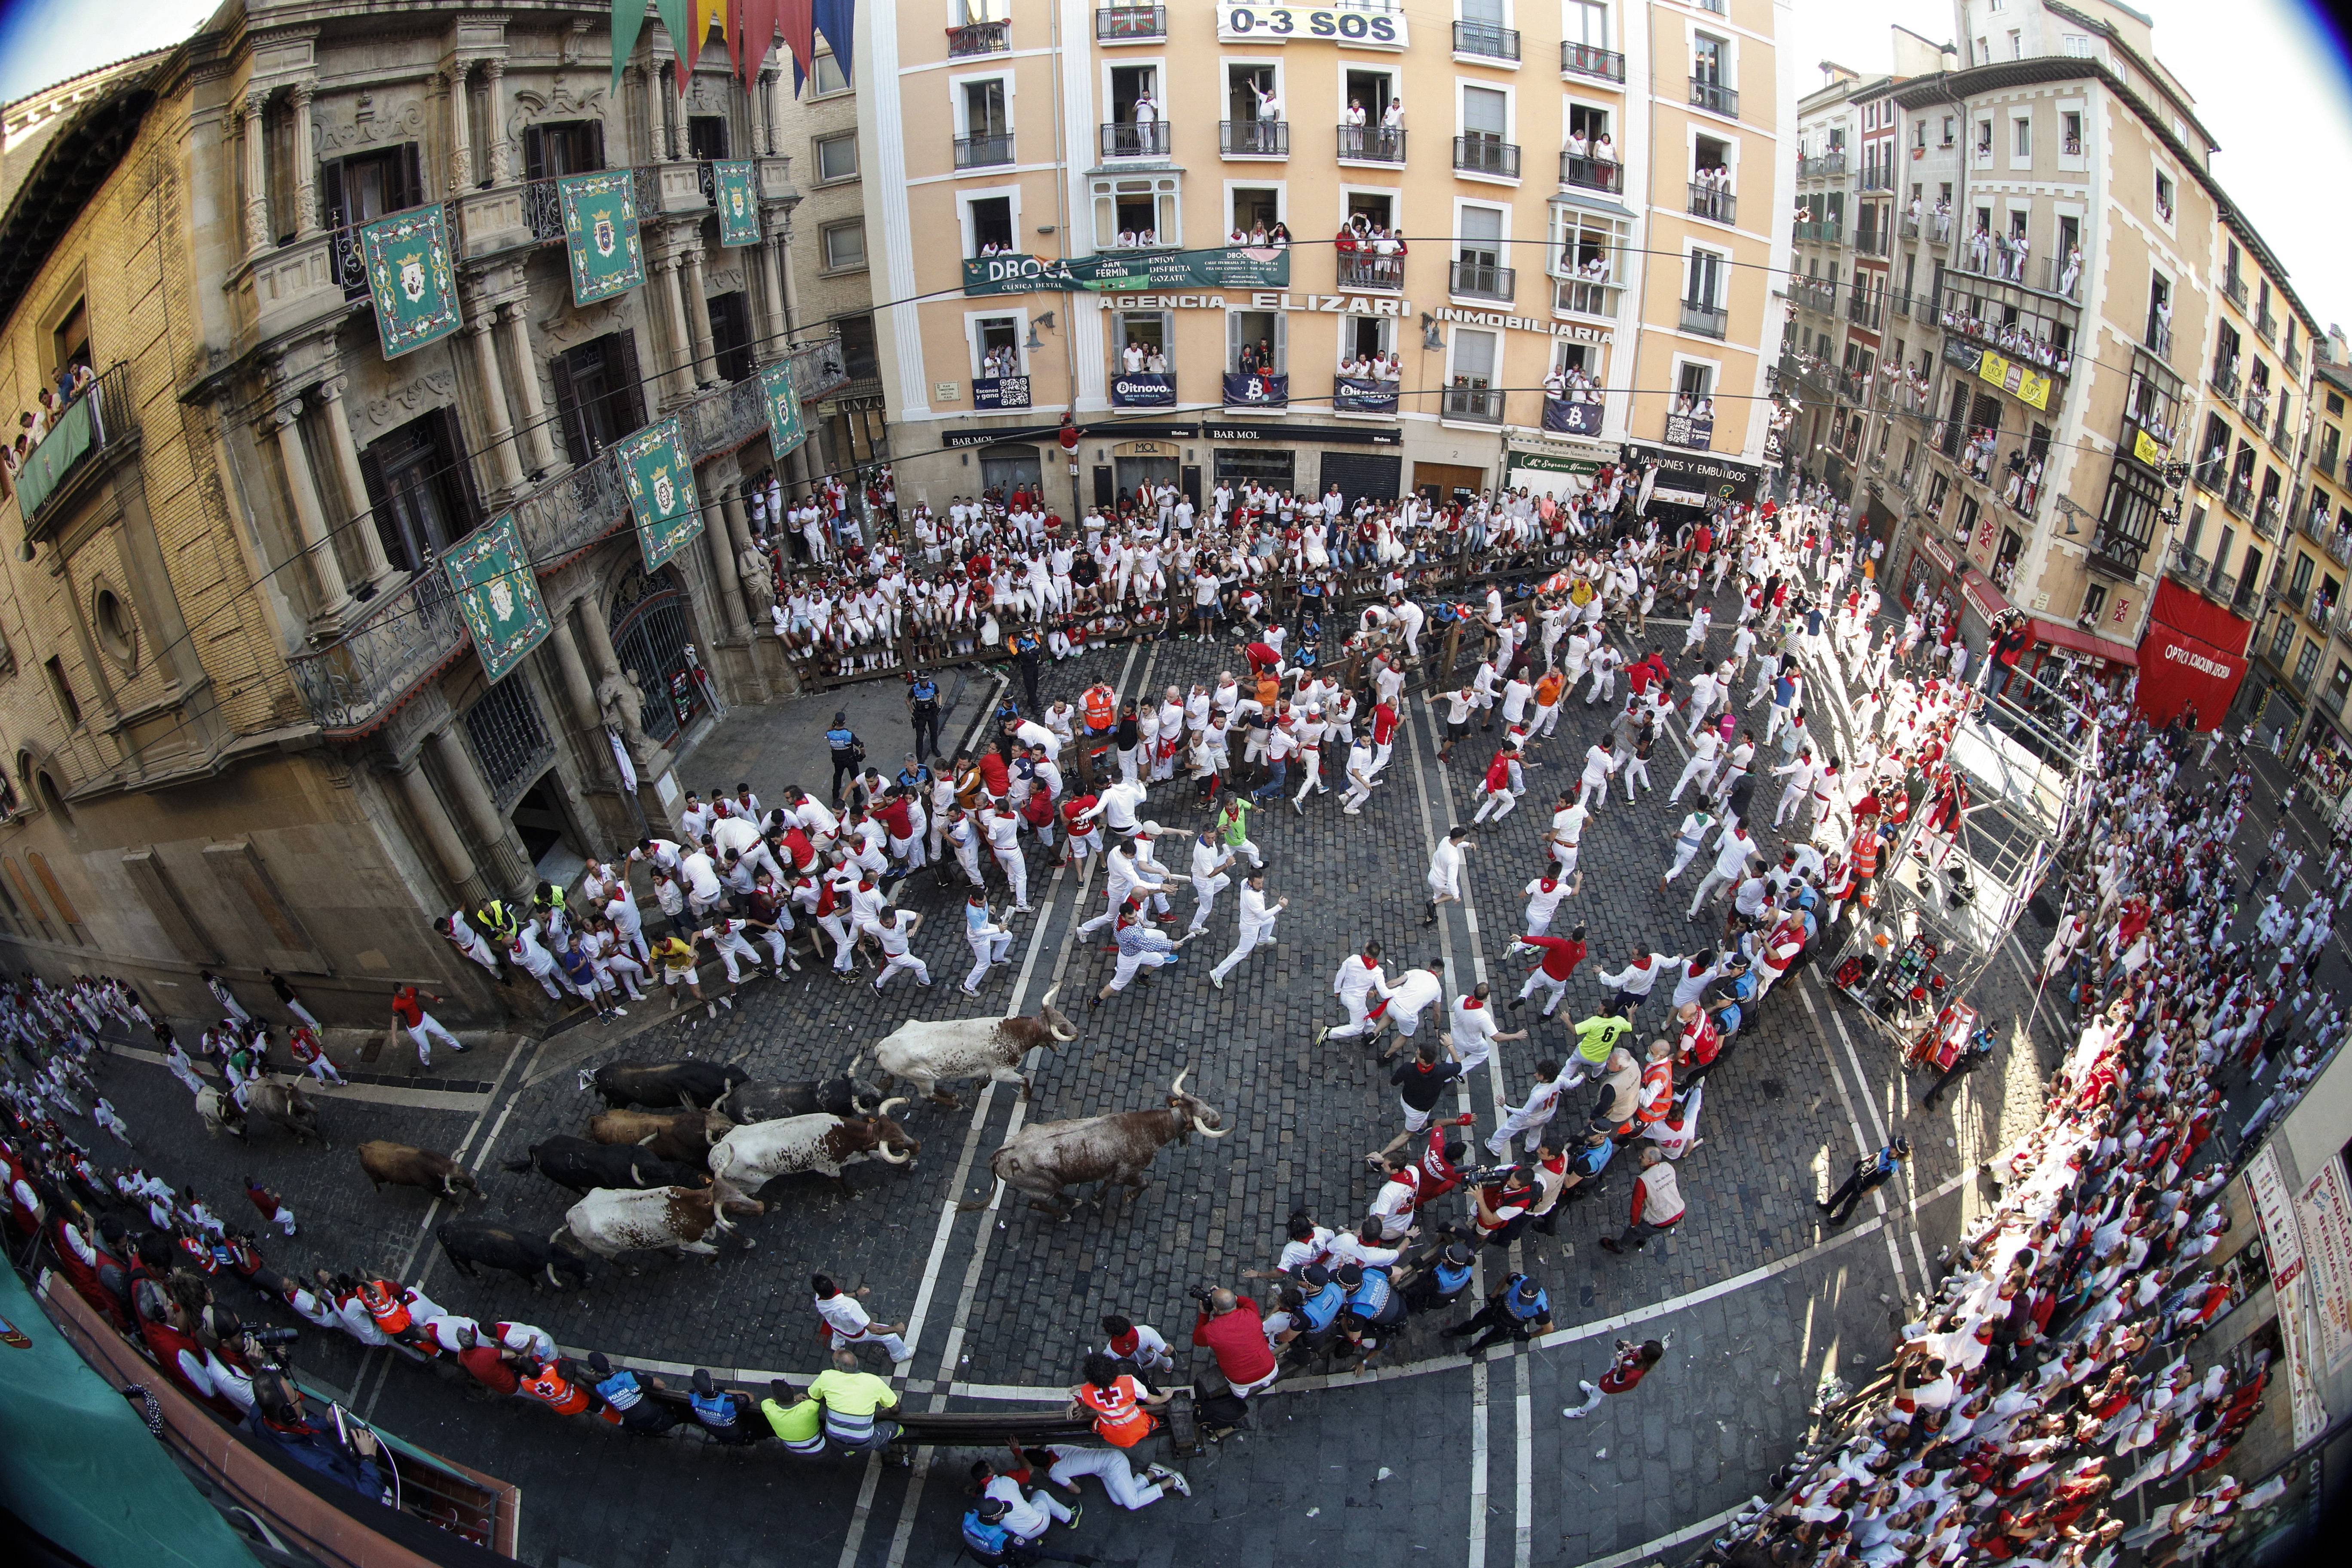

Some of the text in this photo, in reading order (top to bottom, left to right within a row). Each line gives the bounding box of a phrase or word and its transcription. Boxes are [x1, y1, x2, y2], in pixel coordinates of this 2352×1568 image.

[1230, 9, 1395, 41] 0-3 SOS
[989, 259, 1073, 282] DBOCA
[1096, 267, 1128, 278] FERMÍN
[1102, 260, 1120, 268] SAN
[1097, 293, 1411, 317] AGENCIA ELIZARI
[1436, 306, 1615, 345] INMOBILIARIA
[1213, 430, 1260, 439] BAR MOL
[1135, 443, 1157, 452] MOL
[1541, 459, 1569, 468] Sagrario
[1569, 463, 1595, 472] Navarro
[1688, 463, 1694, 472] Y
[2165, 644, 2190, 665] OPTICA
[1602, 1026, 1615, 1043] 6
[2312, 1198, 2326, 1212] DOG
[2317, 1189, 2330, 1202] HOT
[2323, 1165, 2352, 1258] BOCADILLOS
[2327, 1212, 2351, 1299] HOT SANDWICHES
[2294, 1197, 2334, 1357] KALIMOTXO CERVEZA COFFEE
[2313, 1227, 2323, 1254] COLD
[2326, 1296, 2340, 1327] BEER
[2318, 1215, 2348, 1333] BEBIDAS FRIAS
